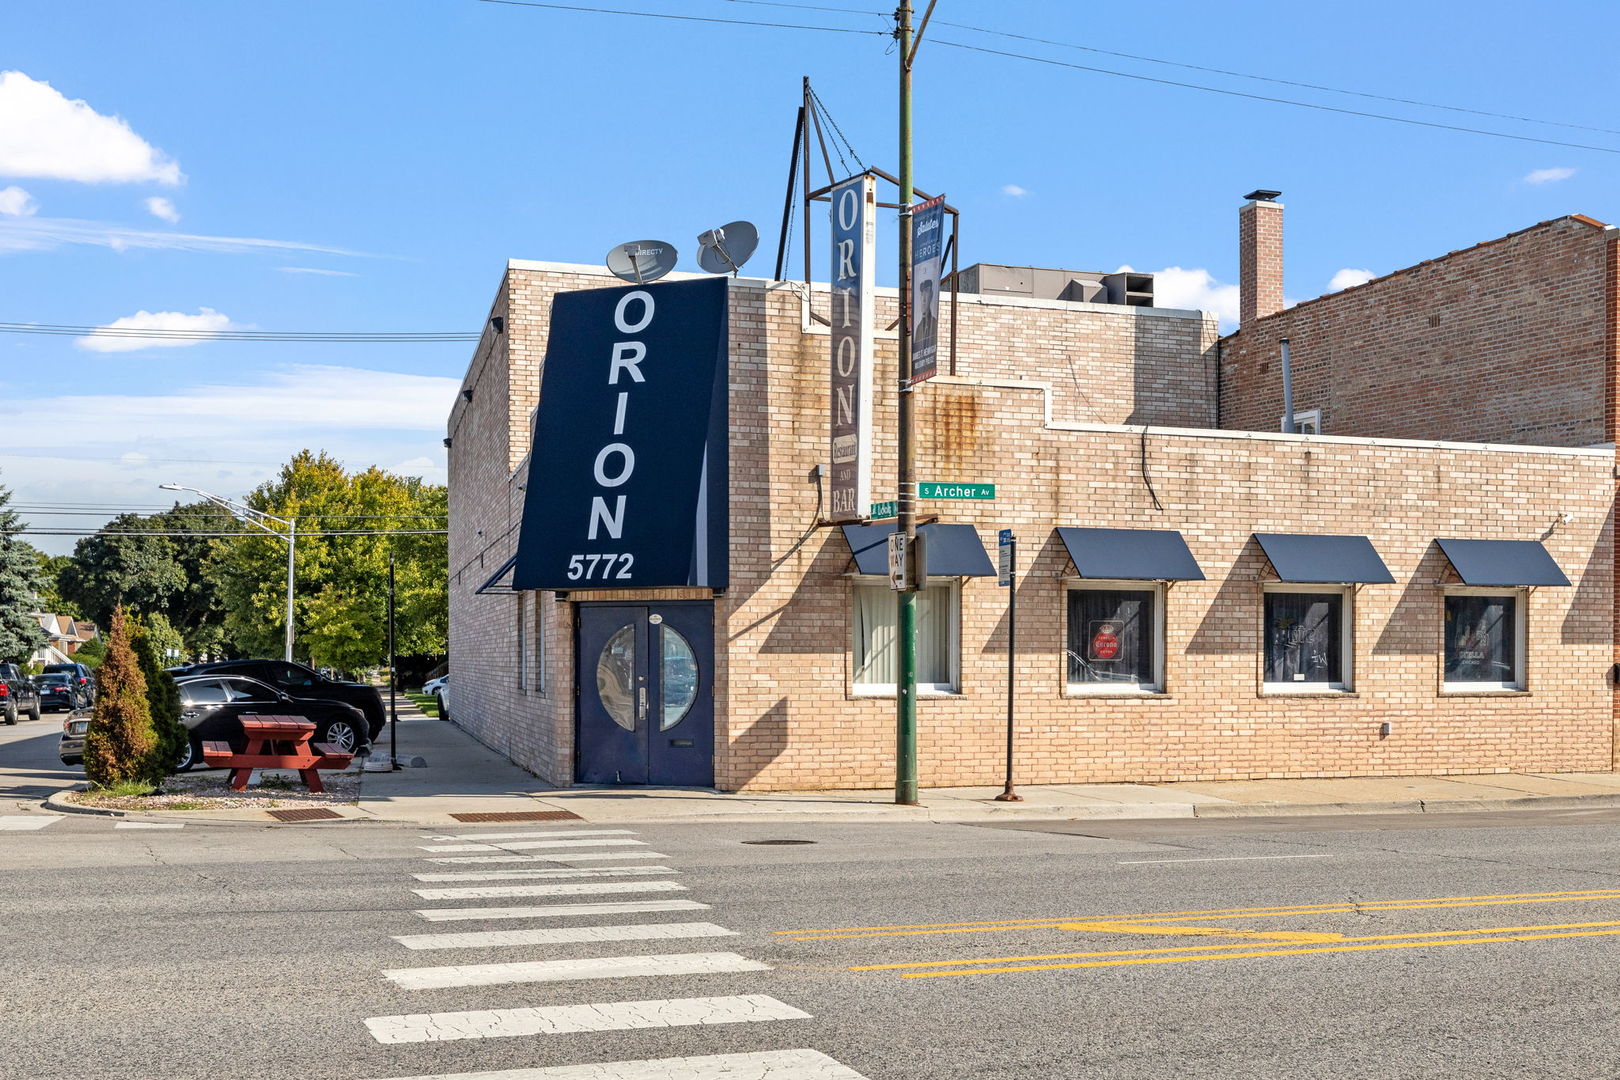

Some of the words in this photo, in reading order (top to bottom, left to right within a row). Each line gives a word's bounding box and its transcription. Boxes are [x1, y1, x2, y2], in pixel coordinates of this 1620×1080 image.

[915, 242, 941, 259] HEROES
[836, 189, 858, 427] ORION
[588, 290, 655, 540] ORION
[840, 469, 851, 481] AND
[833, 488, 856, 513] BAR
[924, 487, 929, 495] S
[934, 485, 976, 497] Archer
[981, 488, 990, 496] Av
[567, 553, 633, 580] 5772
[890, 553, 904, 567] AY
